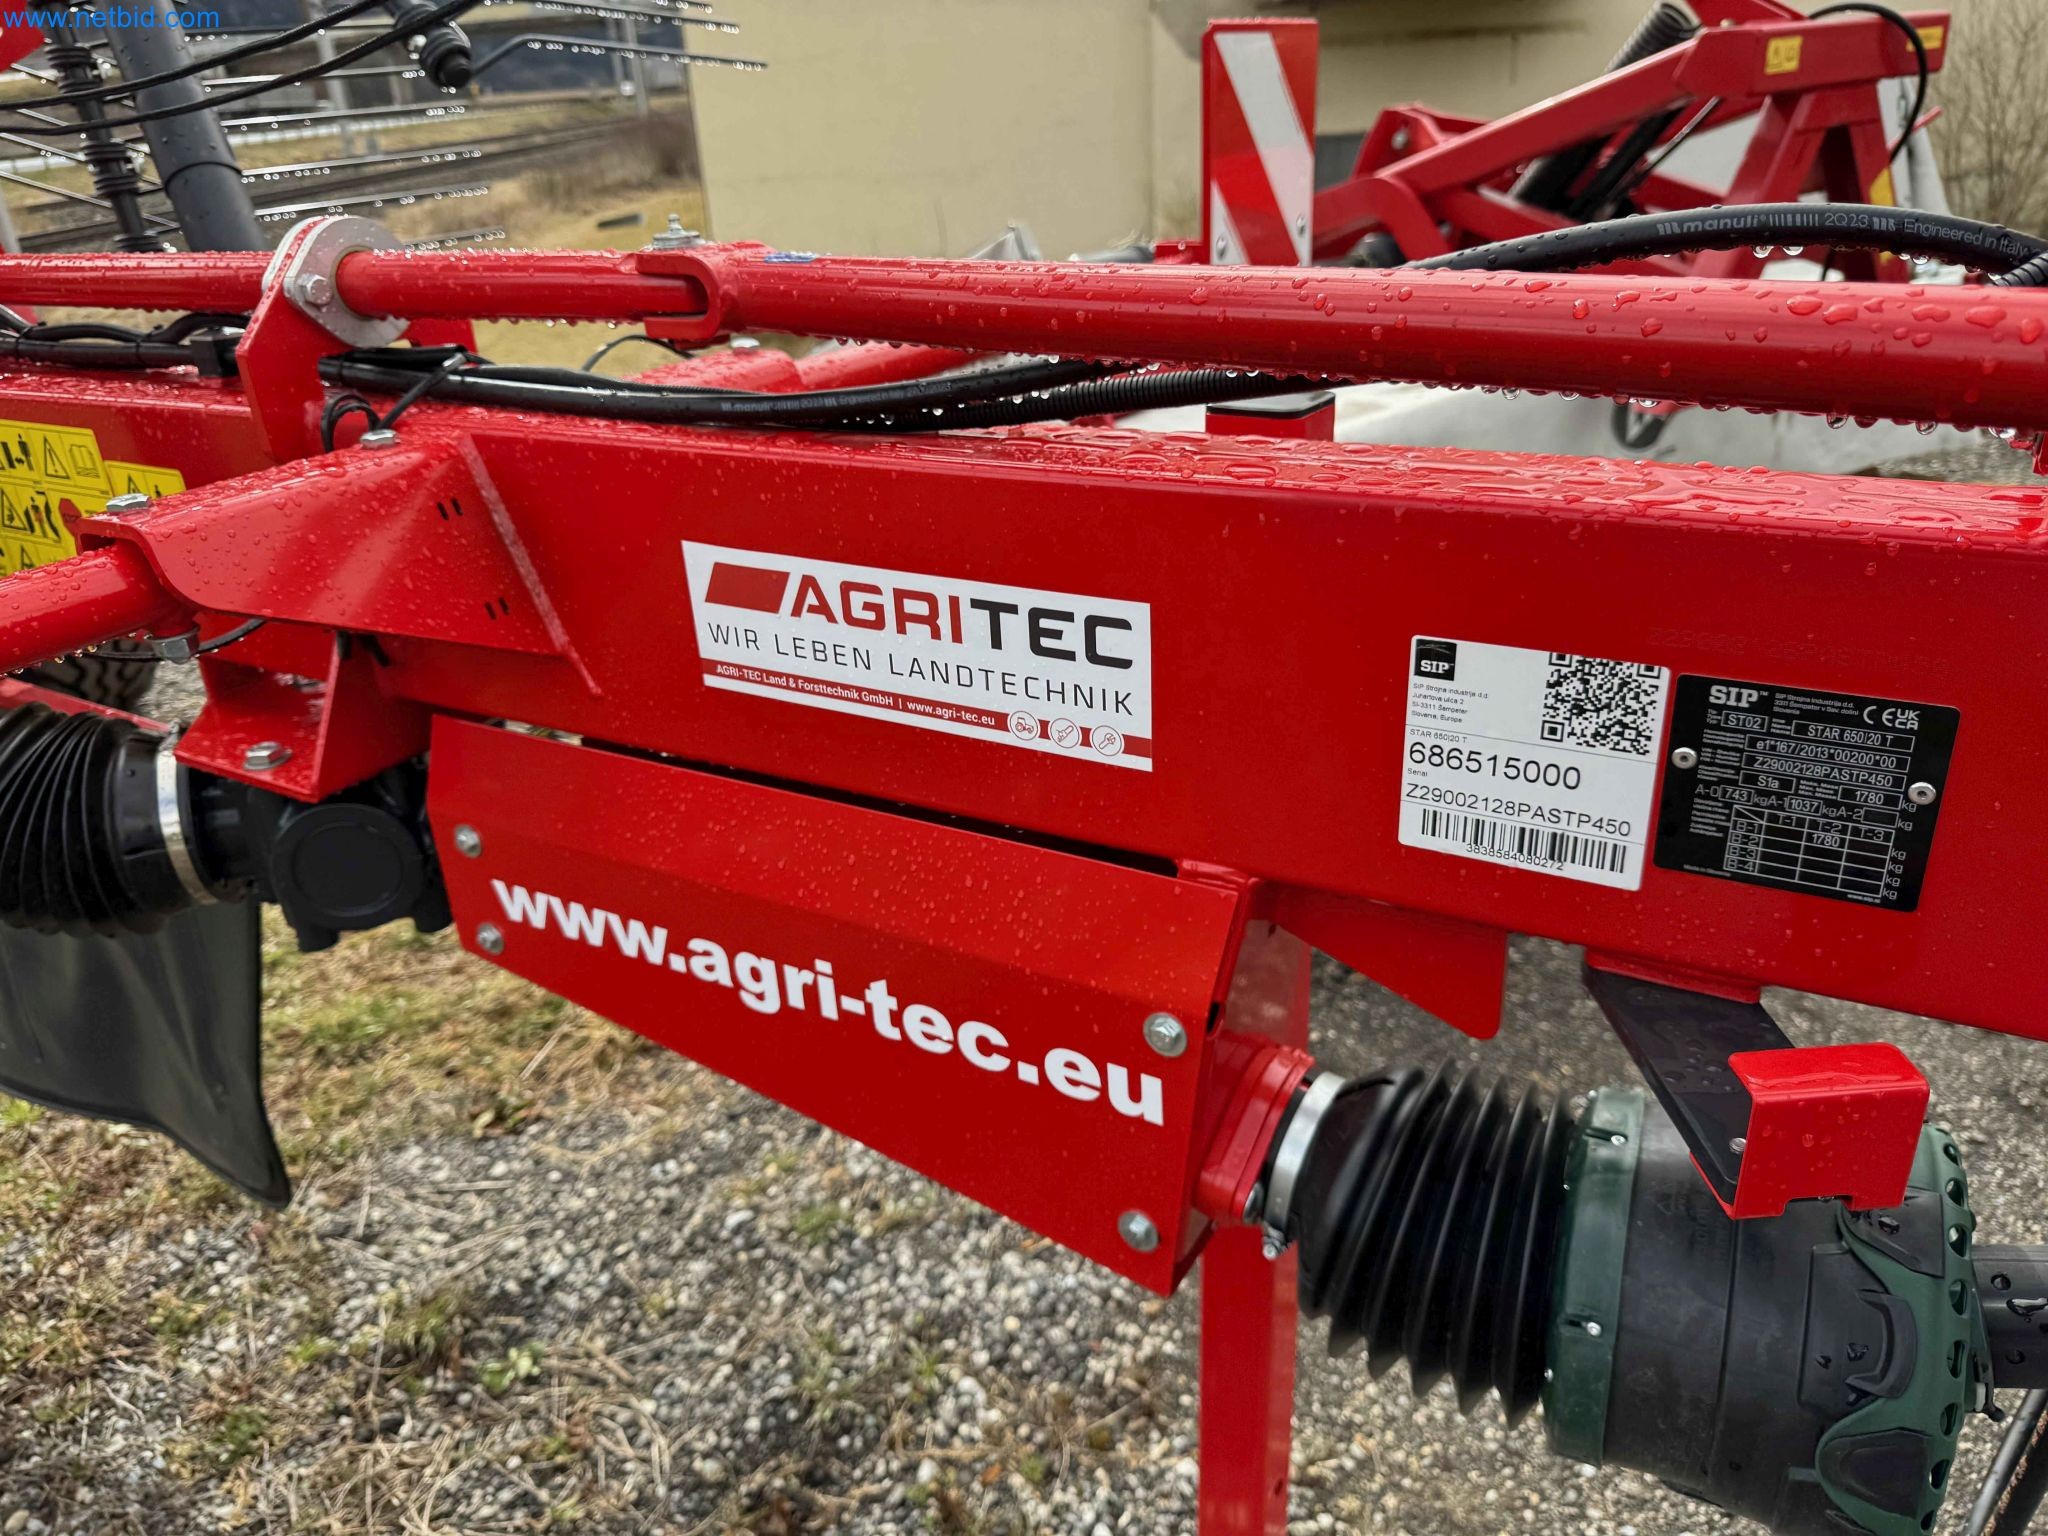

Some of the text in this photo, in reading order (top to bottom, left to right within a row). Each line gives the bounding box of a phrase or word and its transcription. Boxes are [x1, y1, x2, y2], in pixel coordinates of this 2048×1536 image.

[1682, 215, 1759, 233] manuli
[1904, 219, 1983, 244] Engineered
[1985, 237, 1996, 248] in
[2000, 239, 2028, 257] Italy
[790, 574, 1133, 670] AGRITEC
[707, 622, 1133, 716] WIR LEBEN LANDTECHNIK
[1420, 660, 1449, 674] SIP
[716, 664, 995, 726] AGRI-TEC Land & Forsttechnik GmbH www.agri-tec.eu
[1709, 685, 1759, 708] SIP
[1728, 714, 1761, 729] ST02
[1894, 719, 1919, 730] CA
[1896, 708, 1921, 721] UK
[1410, 728, 1432, 738] STAR
[1807, 725, 1841, 740] STAR
[1885, 735, 1894, 747] T
[1407, 767, 1428, 777] Serial
[1409, 741, 1581, 790] 686515000
[1753, 756, 1893, 787] Z29002128PASTP450
[1757, 775, 1779, 789] S1a
[1406, 782, 1631, 837] Z29002128PASTP450
[1726, 788, 1748, 801] 743
[1791, 799, 1819, 812] 1037
[1897, 818, 1913, 831] kg
[1855, 790, 1918, 813] 1780 kg
[1736, 820, 1907, 861] B-1 1780 kg
[1777, 813, 1885, 841] T-1 T-2 T-3
[1466, 842, 1564, 871] 3838584080272
[1729, 845, 1901, 887] B-3 kg
[1731, 832, 1904, 874] B-2 kg
[1727, 857, 1754, 872] B-4
[1882, 887, 1898, 900] kg
[491, 879, 1164, 1127] www.agri-tec.eu
